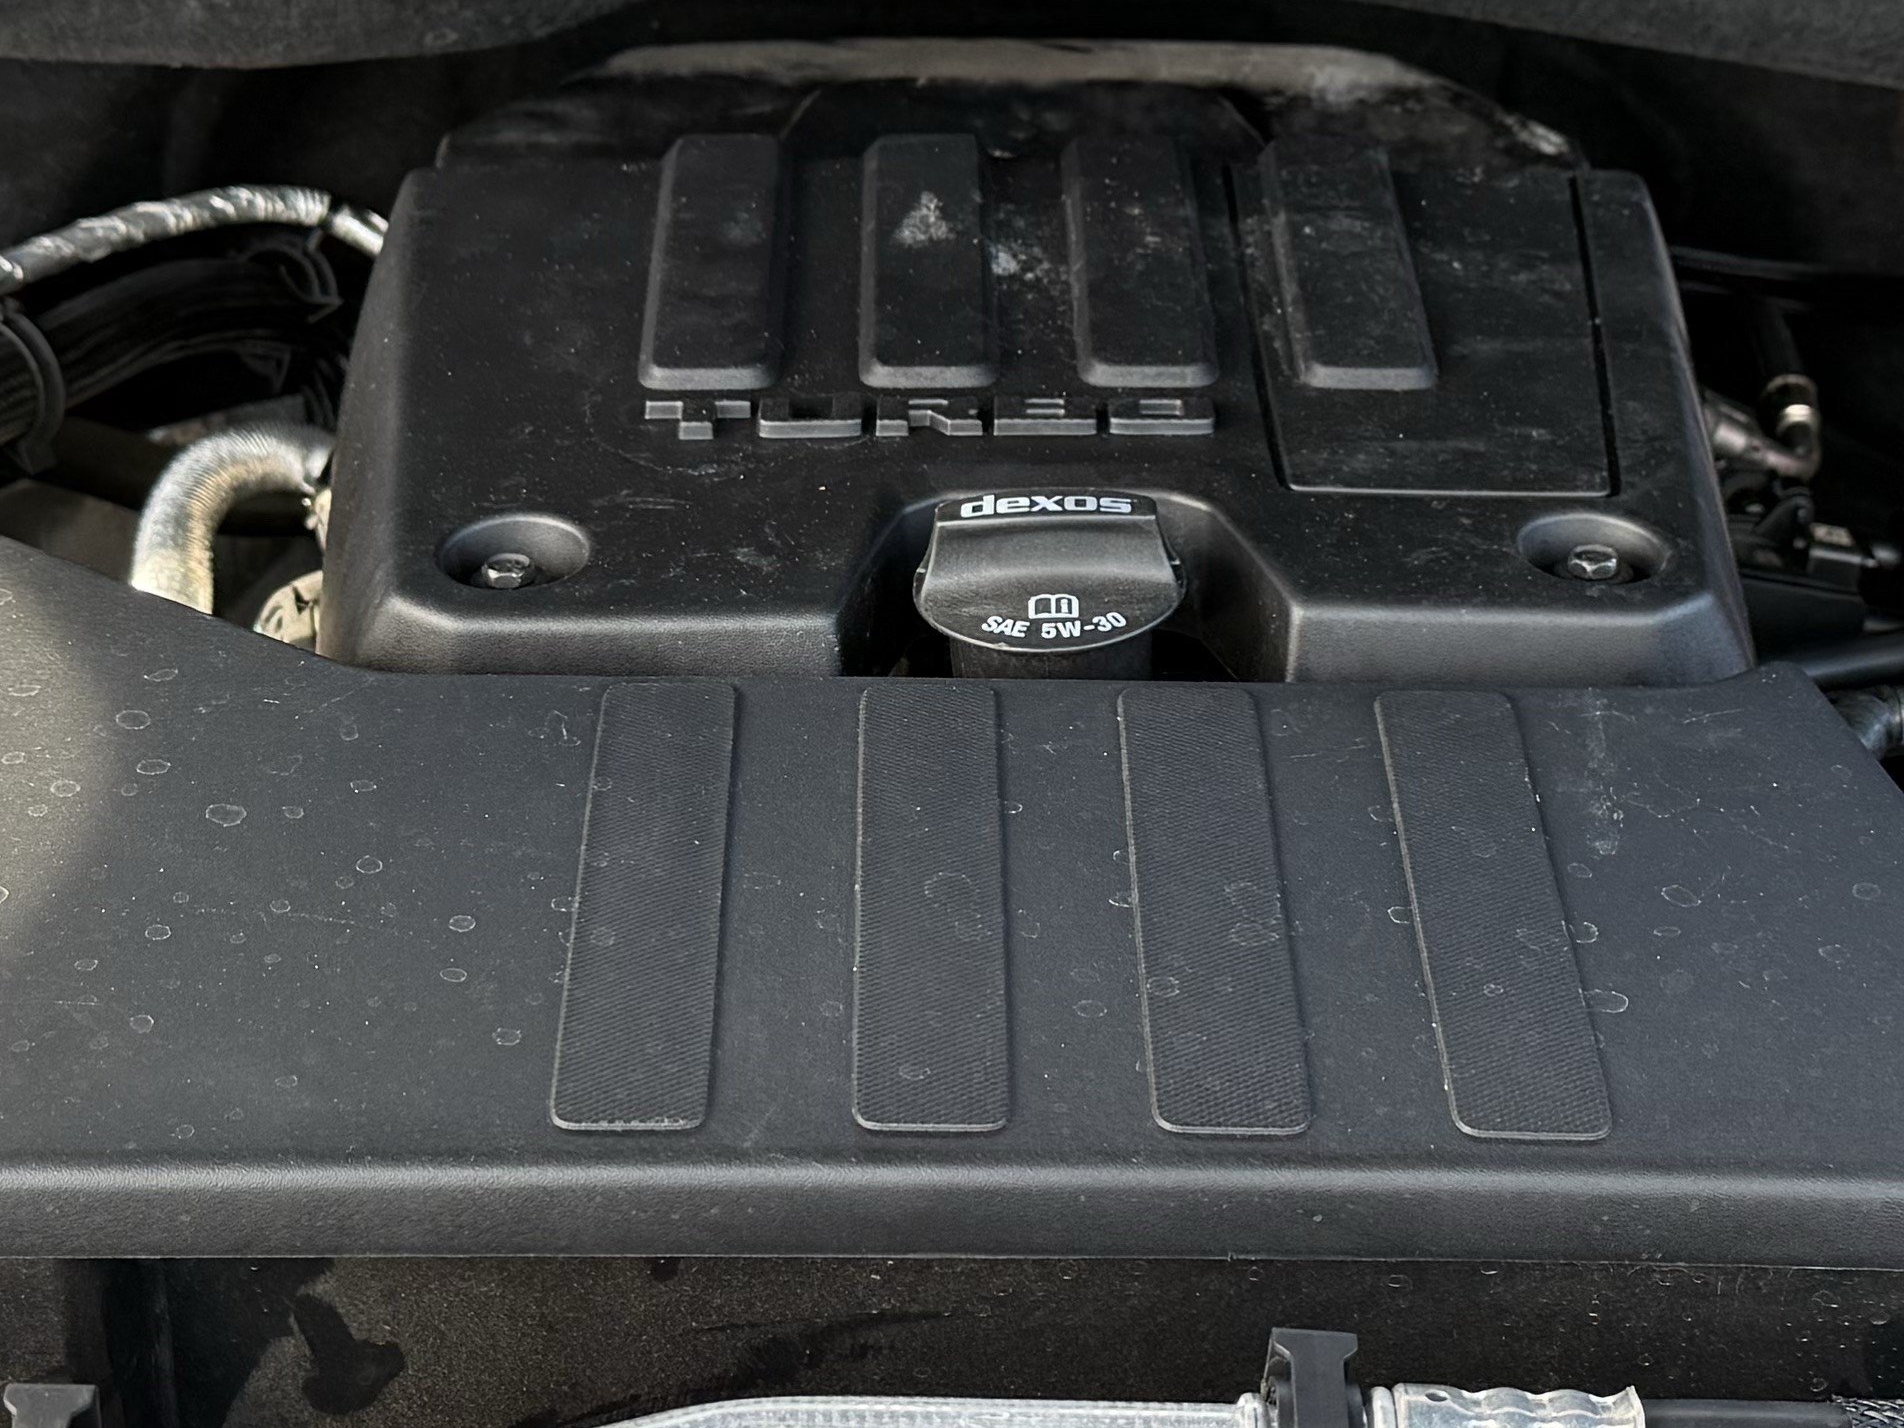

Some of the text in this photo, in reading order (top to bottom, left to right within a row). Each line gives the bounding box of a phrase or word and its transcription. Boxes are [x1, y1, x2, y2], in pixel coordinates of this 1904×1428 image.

[645, 394, 1215, 440] TURBO
[960, 494, 1133, 519] dexos
[981, 611, 1127, 639] SAE 5W-30
